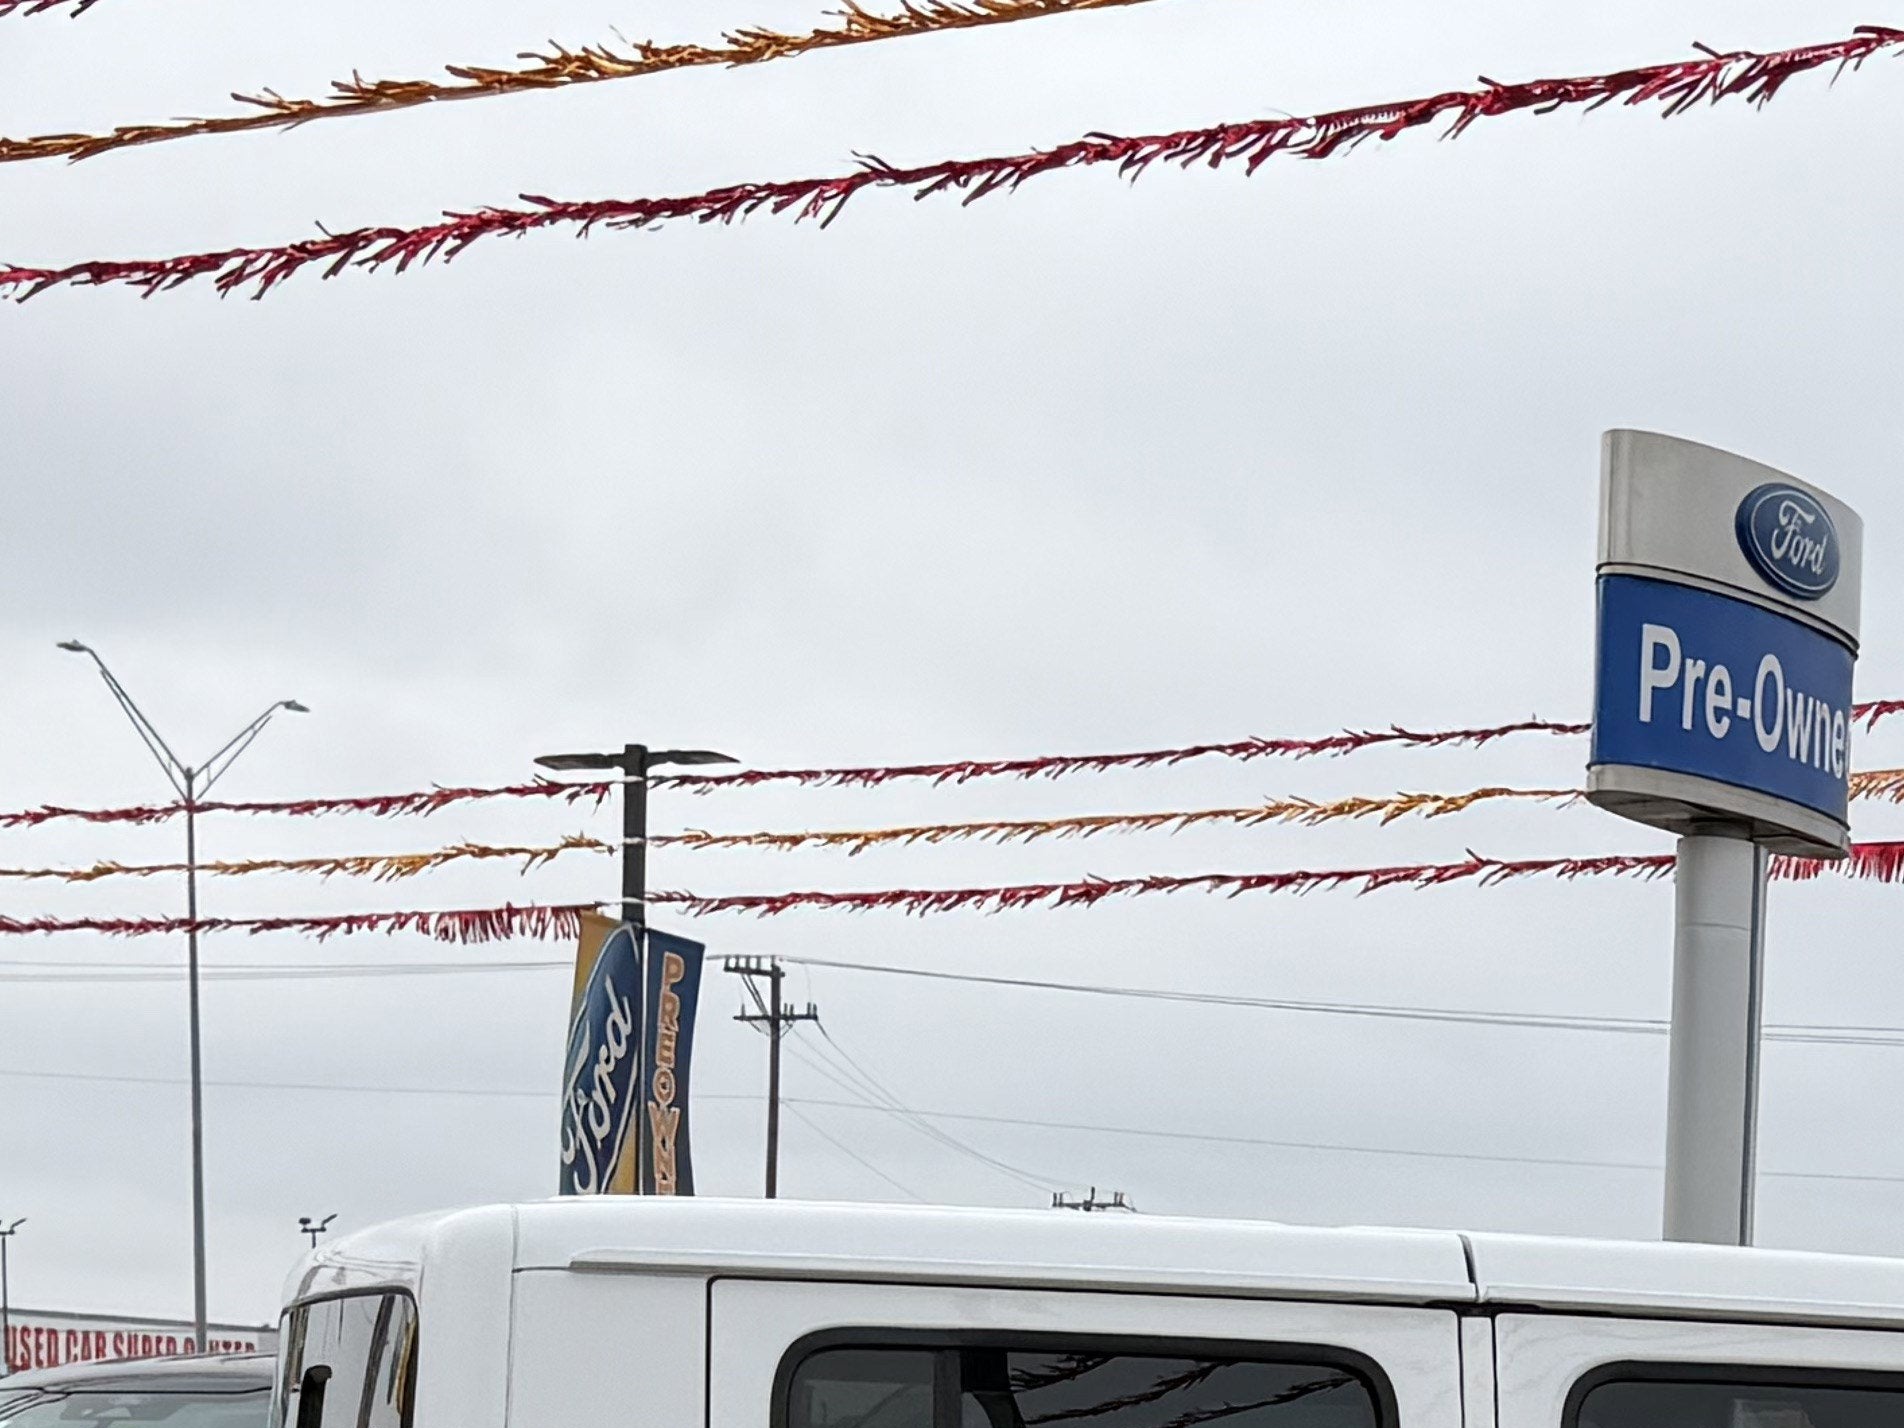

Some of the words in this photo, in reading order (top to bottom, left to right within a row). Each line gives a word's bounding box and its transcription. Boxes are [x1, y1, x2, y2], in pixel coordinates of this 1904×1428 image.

[1770, 499, 1828, 576] Ford
[1639, 622, 1849, 780] Pre-Owne
[561, 973, 632, 1195] Ford
[647, 950, 685, 1196] PREOWN
